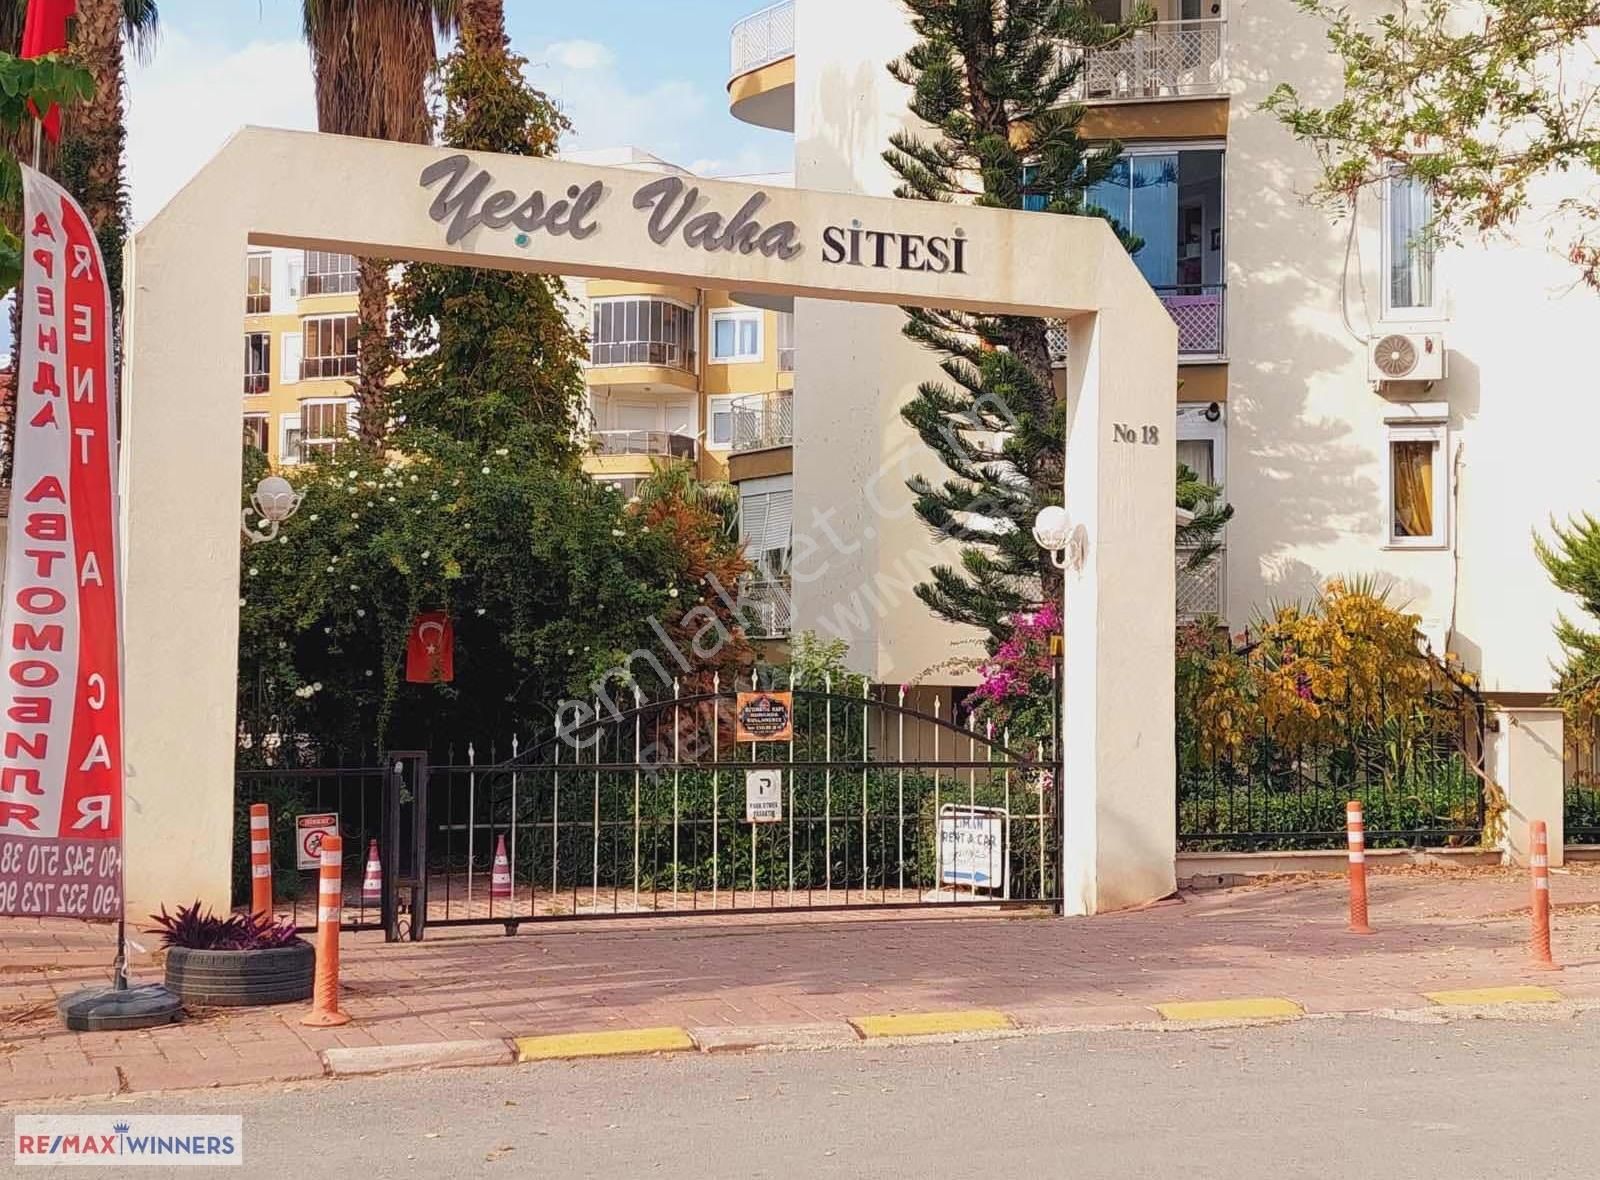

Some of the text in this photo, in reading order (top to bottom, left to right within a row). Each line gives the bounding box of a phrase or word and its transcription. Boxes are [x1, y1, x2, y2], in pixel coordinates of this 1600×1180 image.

[632, 176, 803, 261] Vaha
[822, 218, 969, 275] SİTESİ
[1112, 423, 1159, 445] No 18
